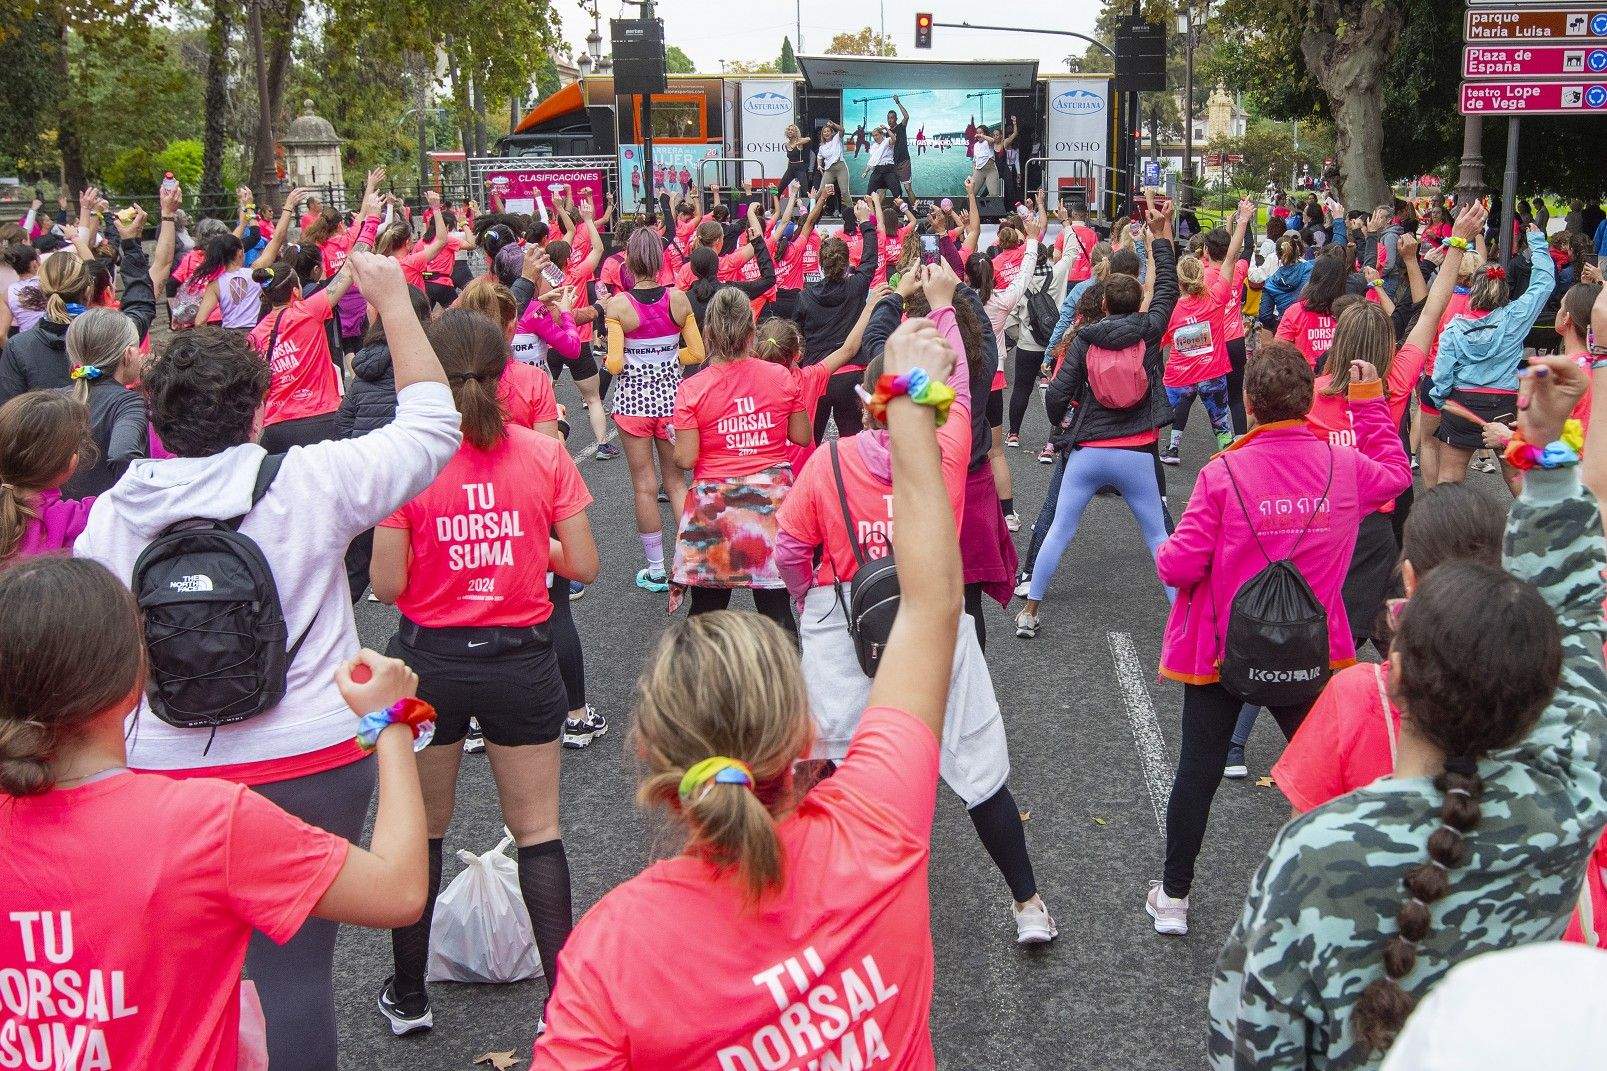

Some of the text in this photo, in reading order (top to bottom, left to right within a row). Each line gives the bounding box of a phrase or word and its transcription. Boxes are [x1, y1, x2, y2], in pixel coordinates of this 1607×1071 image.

[1472, 13, 1520, 25] parque
[1515, 25, 1551, 37] Luisa
[1469, 49, 1532, 61] Plaza de
[1469, 61, 1521, 74] España
[1467, 86, 1541, 99] teatro Lope
[748, 101, 789, 110] ASTURIANA
[1056, 100, 1101, 110] ASTURIANA
[1466, 98, 1526, 110] de Vega
[1055, 141, 1100, 152] OYSHO
[518, 172, 599, 183] CLASIFICACIÓNES
[1318, 316, 1331, 328] TU
[1308, 328, 1336, 340] DORSA
[1312, 340, 1333, 351] SUM
[734, 396, 755, 415] TU
[717, 411, 776, 434] DORSAL
[725, 431, 769, 449] SUMA
[461, 481, 497, 511] TU
[435, 510, 525, 542] DORSAL
[448, 540, 515, 571] SUMA
[467, 577, 495, 592] 2024
[9, 910, 74, 964] TU
[752, 945, 826, 1011] TU
[0, 967, 139, 1022] ORSAL
[716, 954, 899, 1071] DORSAL
[0, 1018, 112, 1071] SUMA
[788, 1017, 891, 1071] MA
